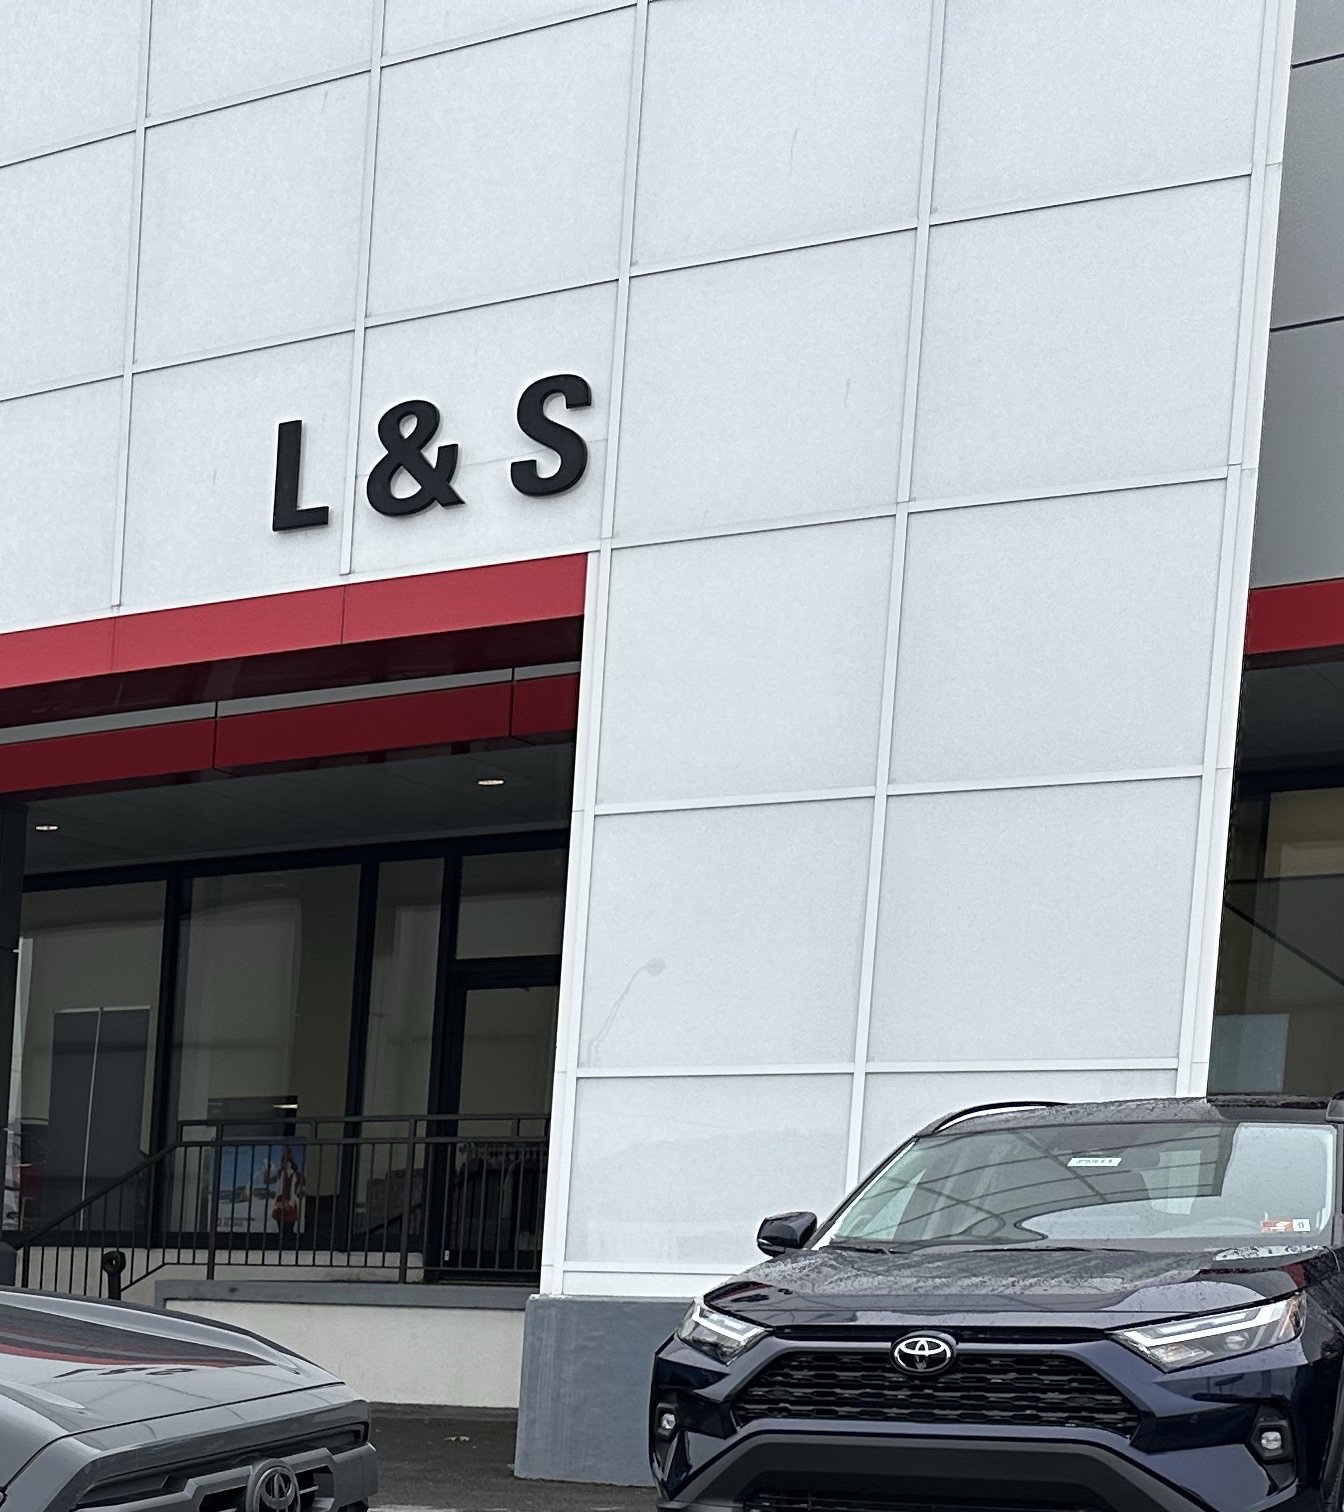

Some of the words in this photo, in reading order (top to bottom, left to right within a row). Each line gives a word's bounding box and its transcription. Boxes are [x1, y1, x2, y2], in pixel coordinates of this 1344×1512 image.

[272, 419, 330, 533] L
[366, 398, 466, 517] &
[510, 373, 592, 498] S
